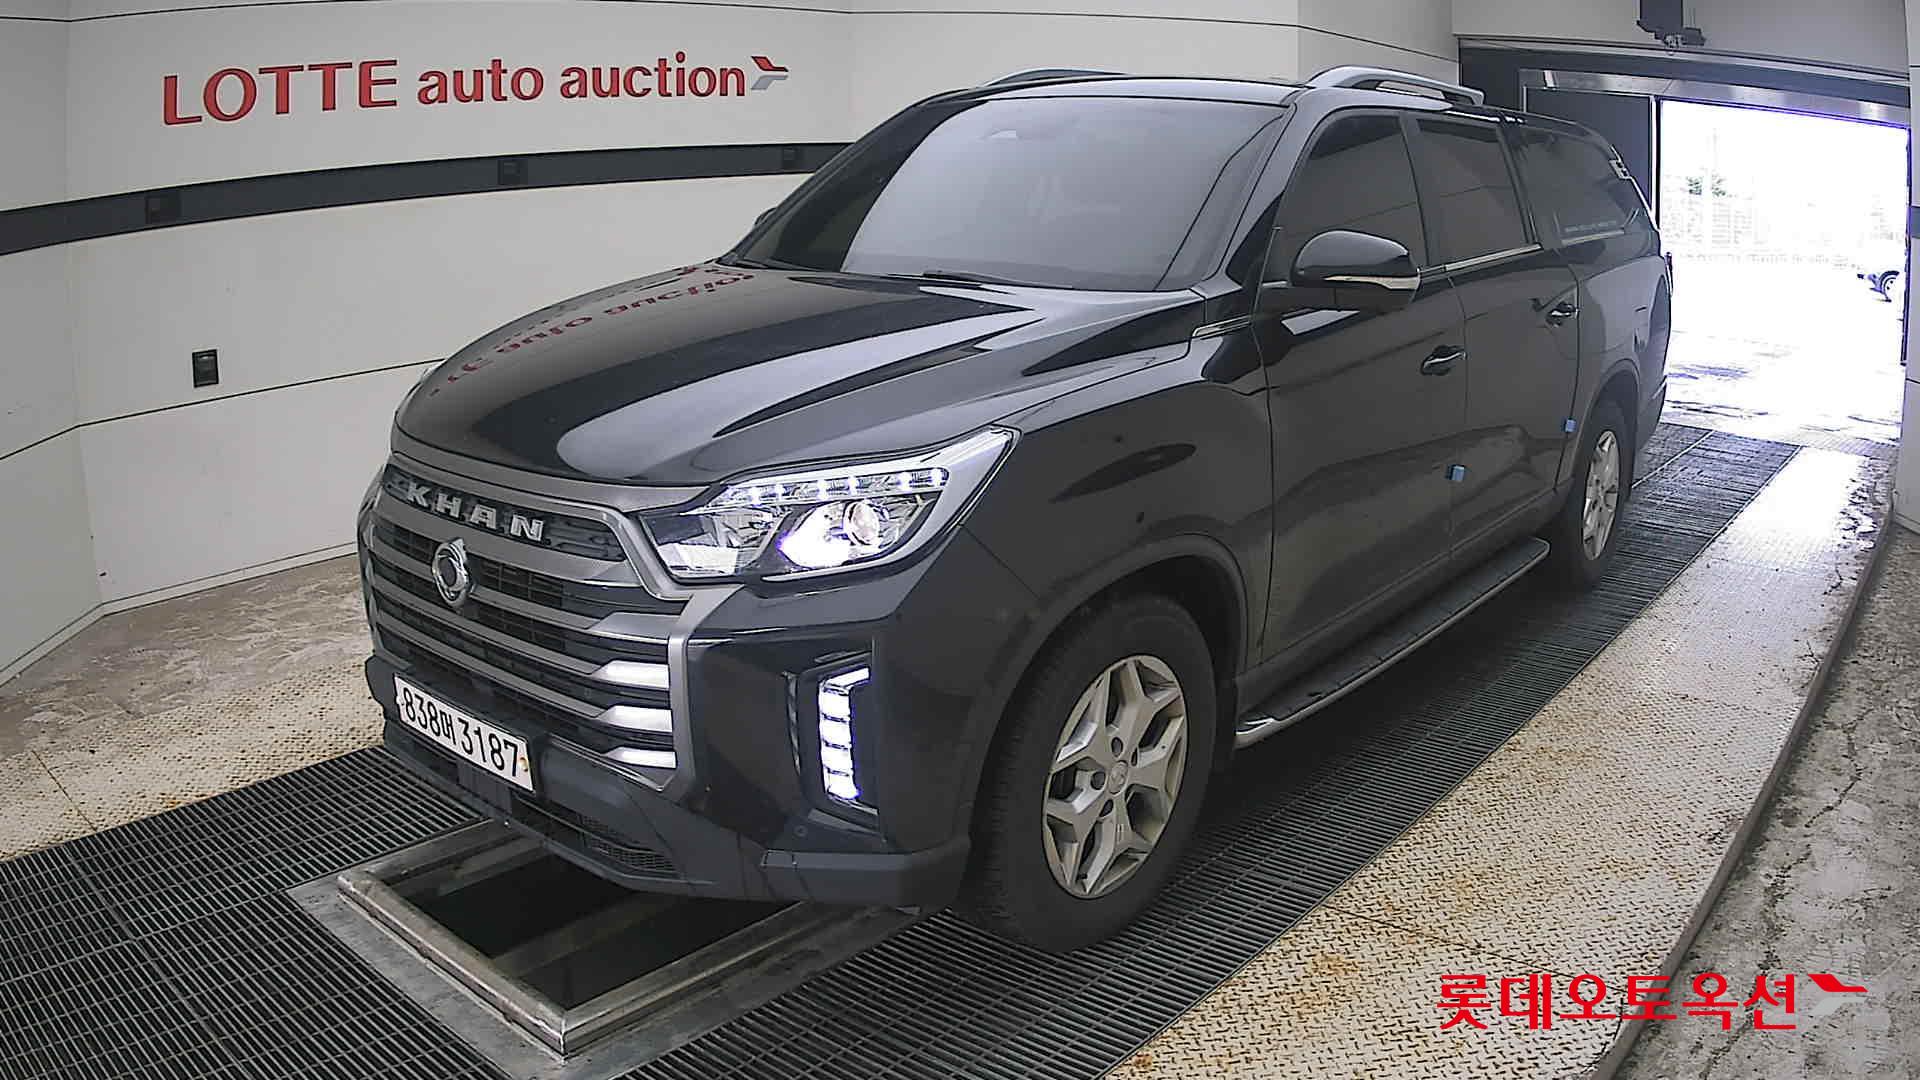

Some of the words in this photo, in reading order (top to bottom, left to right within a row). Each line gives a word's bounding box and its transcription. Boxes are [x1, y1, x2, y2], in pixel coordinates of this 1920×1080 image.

[163, 60, 397, 125] LOTTE
[417, 58, 545, 105] auto
[560, 51, 747, 98] auction
[405, 482, 546, 543] KHAN
